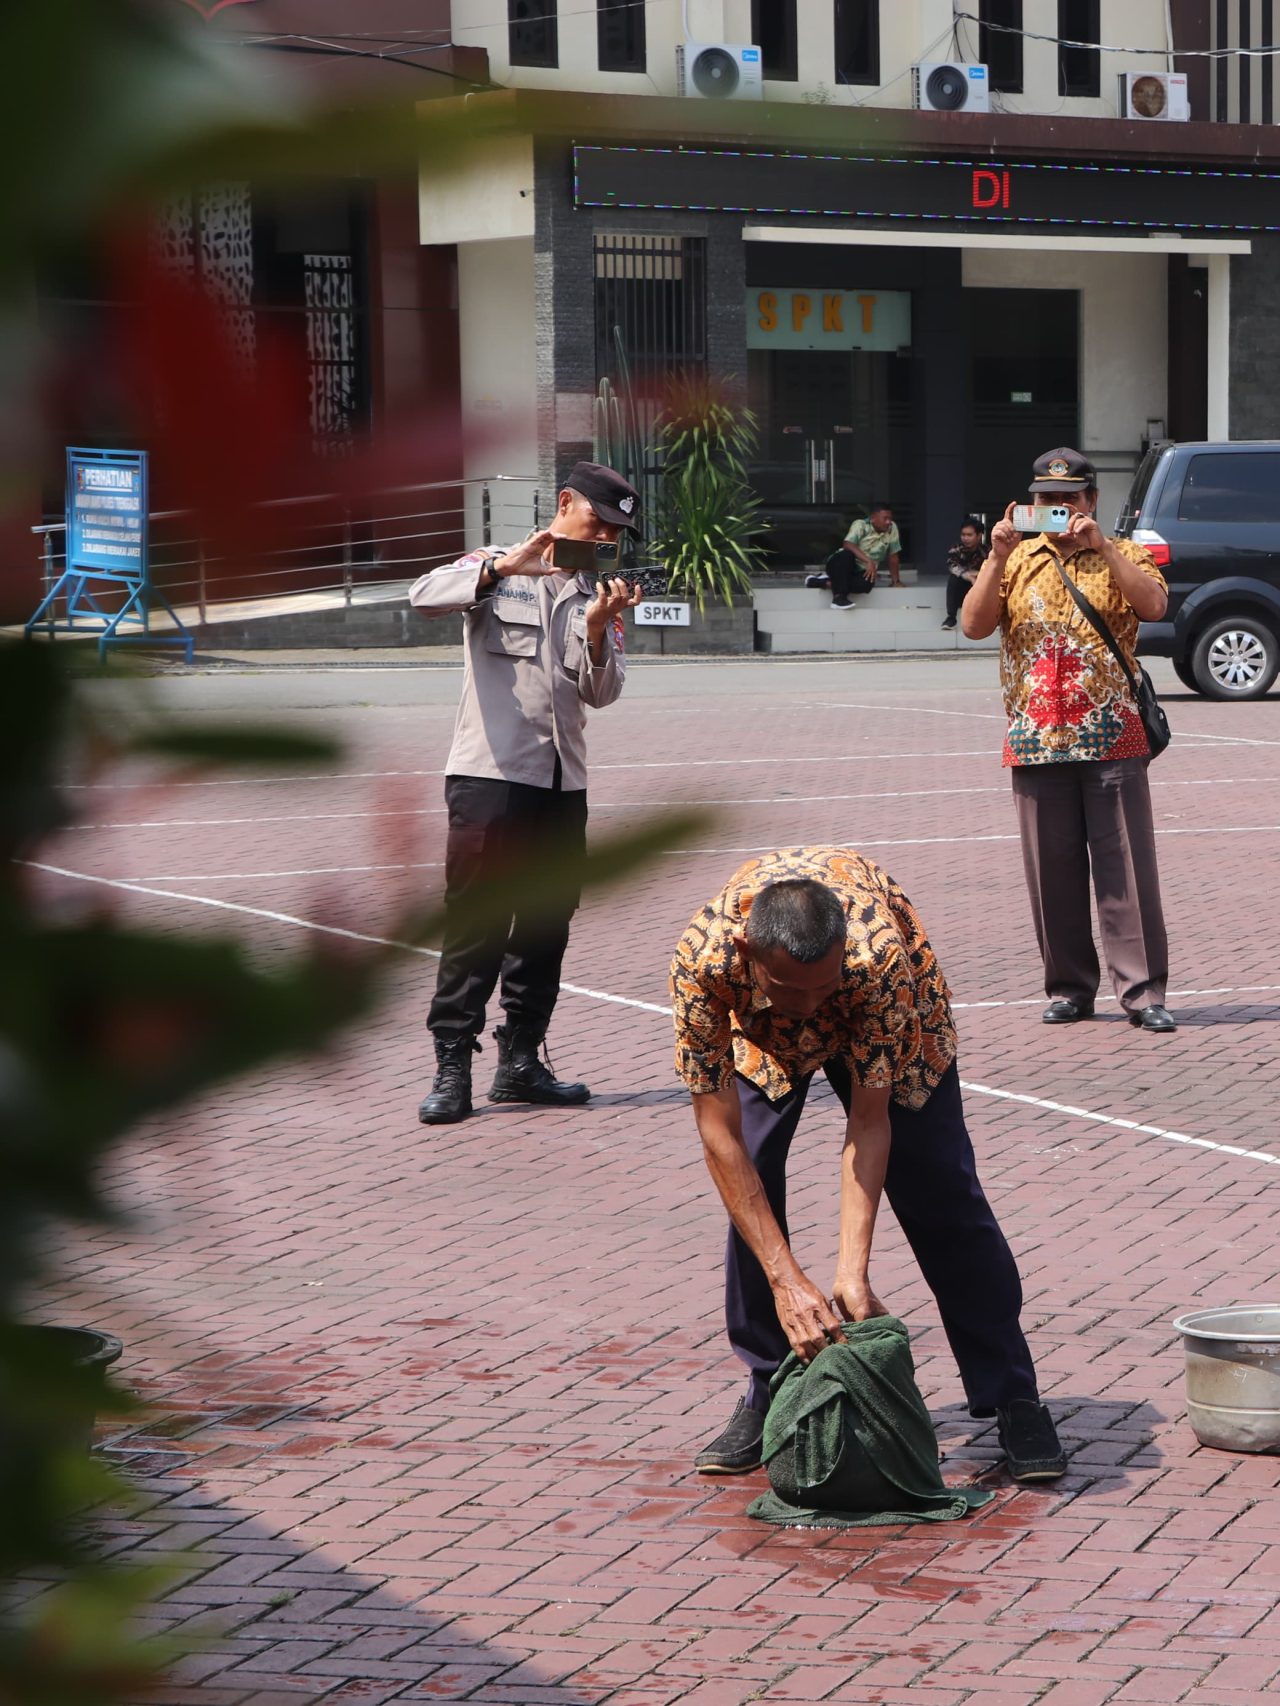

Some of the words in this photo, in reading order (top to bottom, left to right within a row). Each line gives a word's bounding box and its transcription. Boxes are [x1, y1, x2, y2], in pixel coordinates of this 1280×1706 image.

[972, 170, 1009, 208] DI
[758, 291, 877, 334] SPKT
[85, 468, 133, 488] PERHATIAN
[643, 606, 682, 621] SPKT
